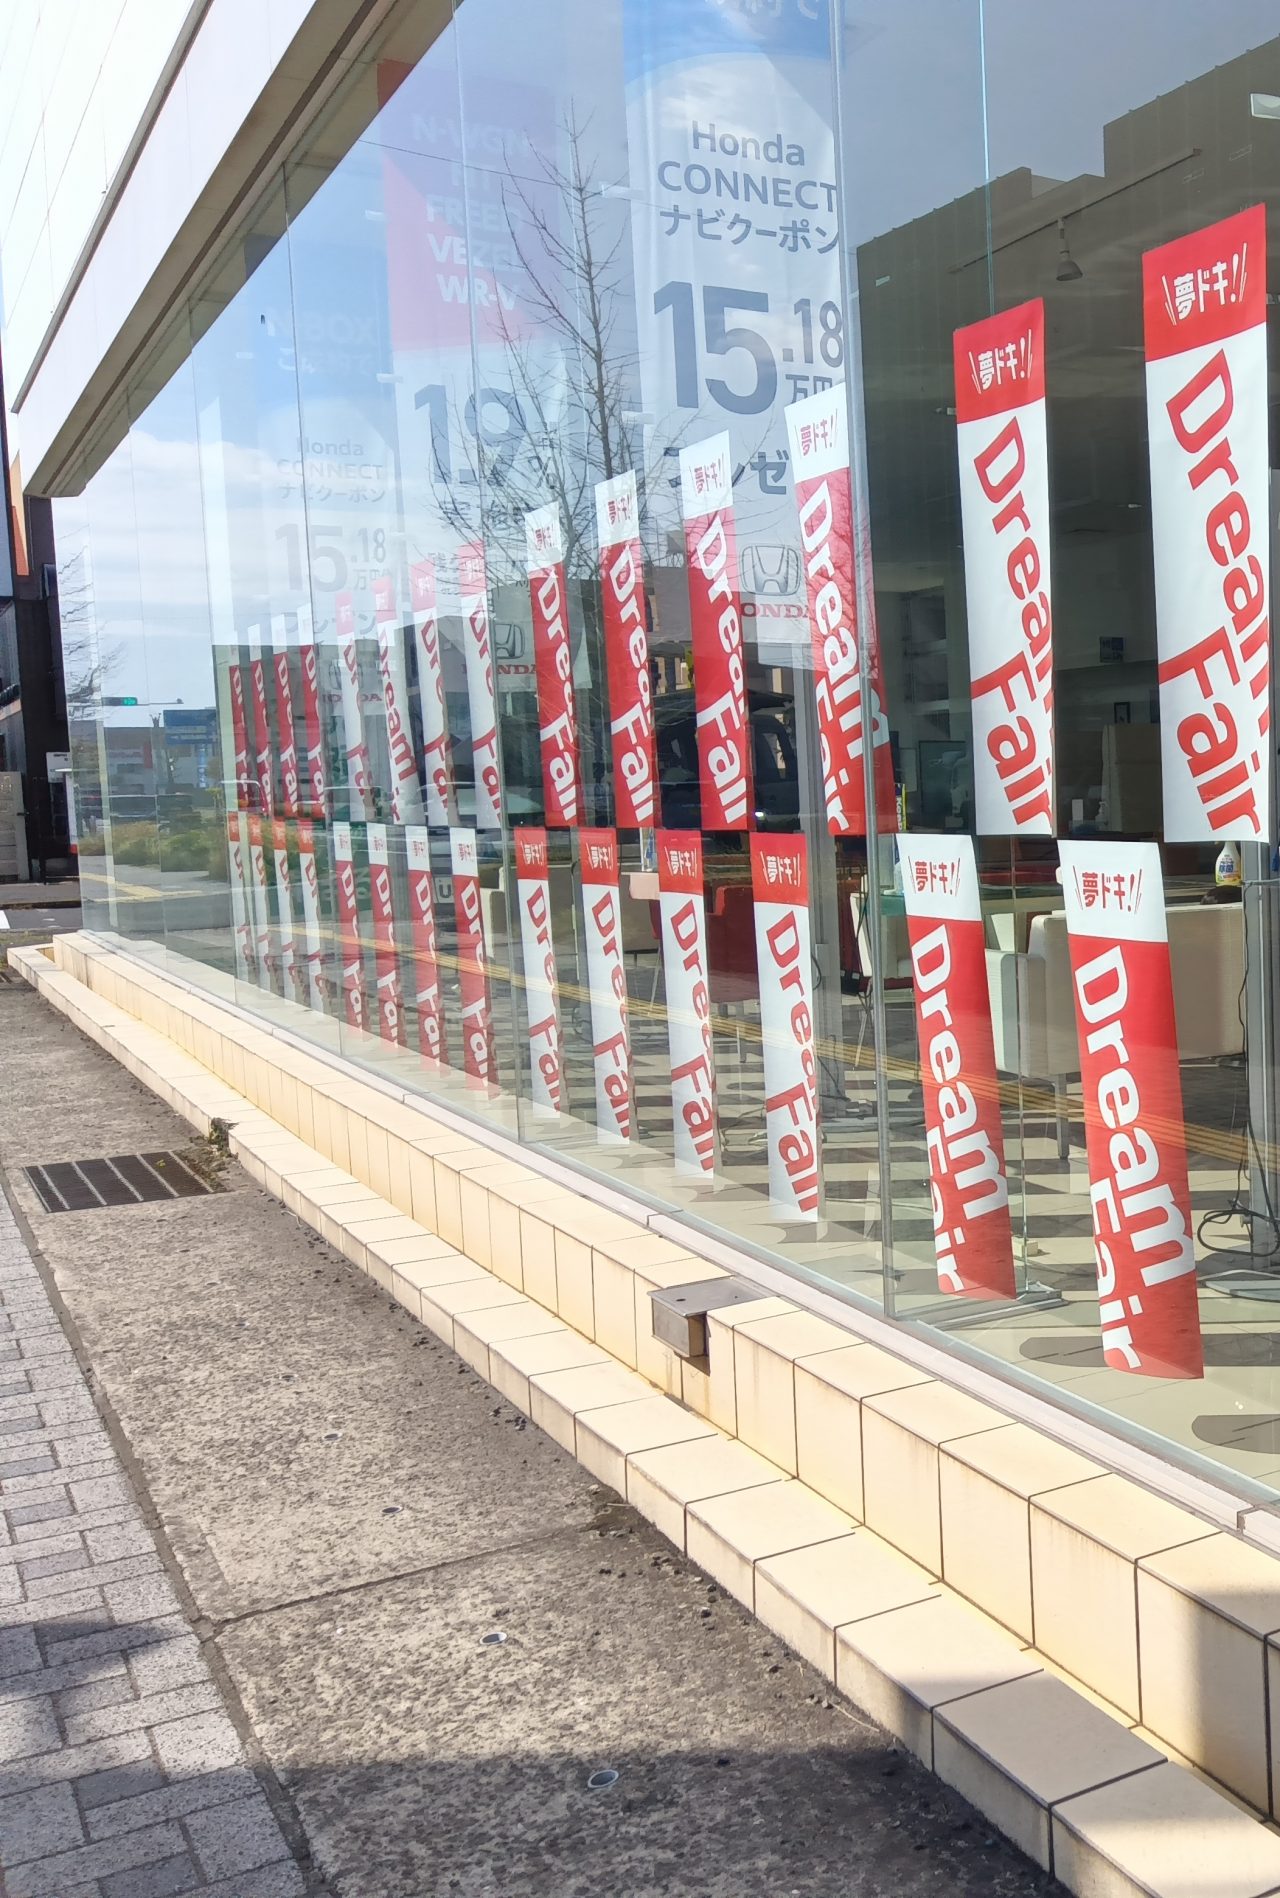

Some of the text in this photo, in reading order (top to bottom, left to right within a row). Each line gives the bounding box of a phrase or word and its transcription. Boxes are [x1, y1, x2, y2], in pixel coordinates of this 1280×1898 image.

[657, 161, 839, 213] CONNECT
[692, 120, 806, 167] Honda
[741, 602, 809, 618] OND
[1158, 626, 1261, 834] Fair
[910, 924, 1008, 1220] Dream
[1074, 945, 1195, 1287] Dream
